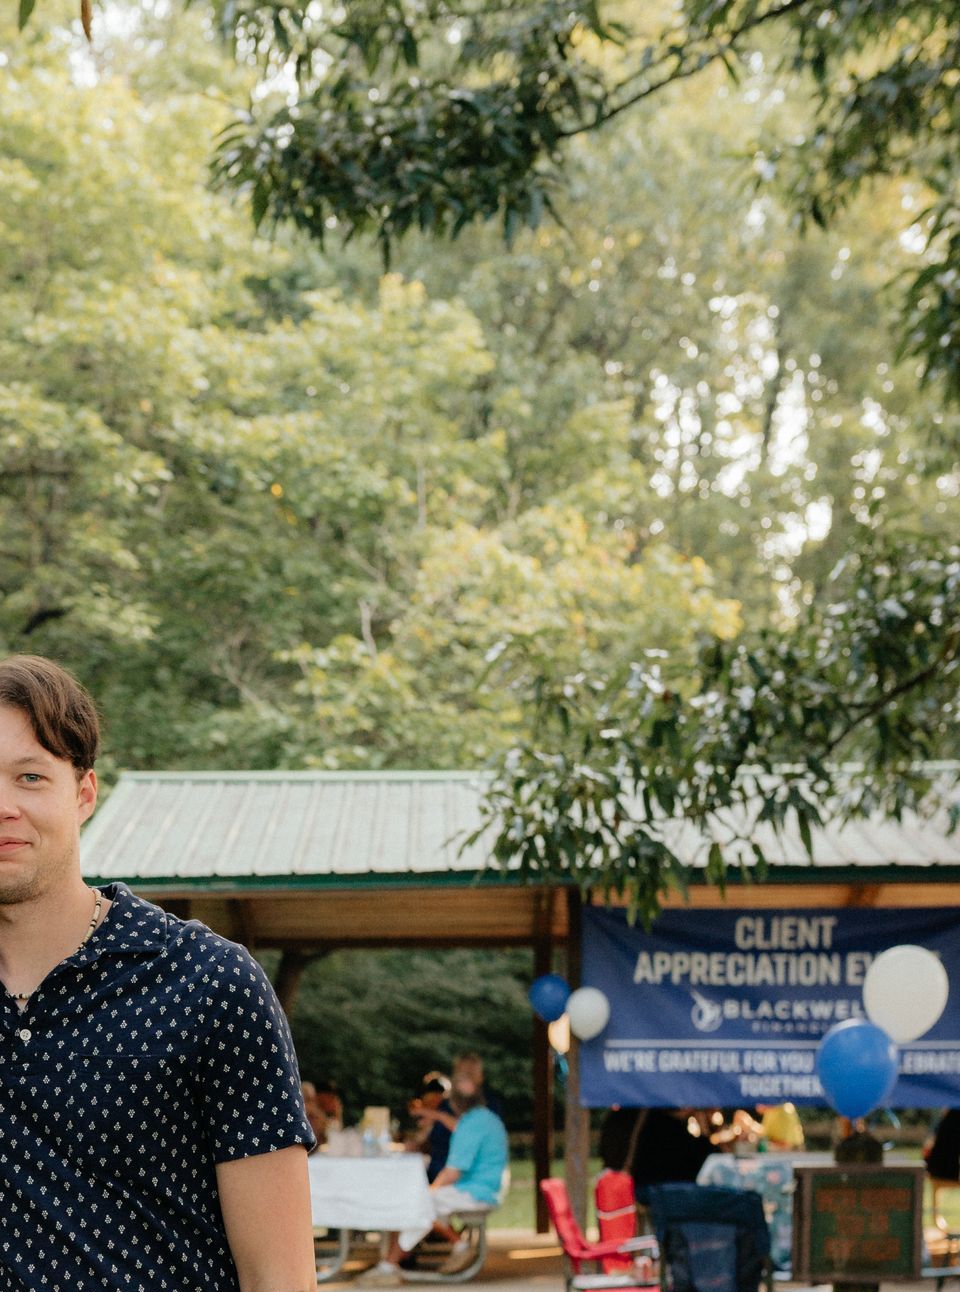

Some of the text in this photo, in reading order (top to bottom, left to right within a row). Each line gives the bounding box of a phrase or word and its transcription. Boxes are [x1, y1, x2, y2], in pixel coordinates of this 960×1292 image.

[735, 916, 837, 950] CLIENT
[633, 951, 840, 986] APPRECIATION
[723, 999, 863, 1020] BLACKWEL
[604, 1051, 657, 1072] WE'RE
[658, 1051, 740, 1073] GRATEFUL
[743, 1051, 778, 1073] FOR
[779, 1051, 815, 1073] YOU
